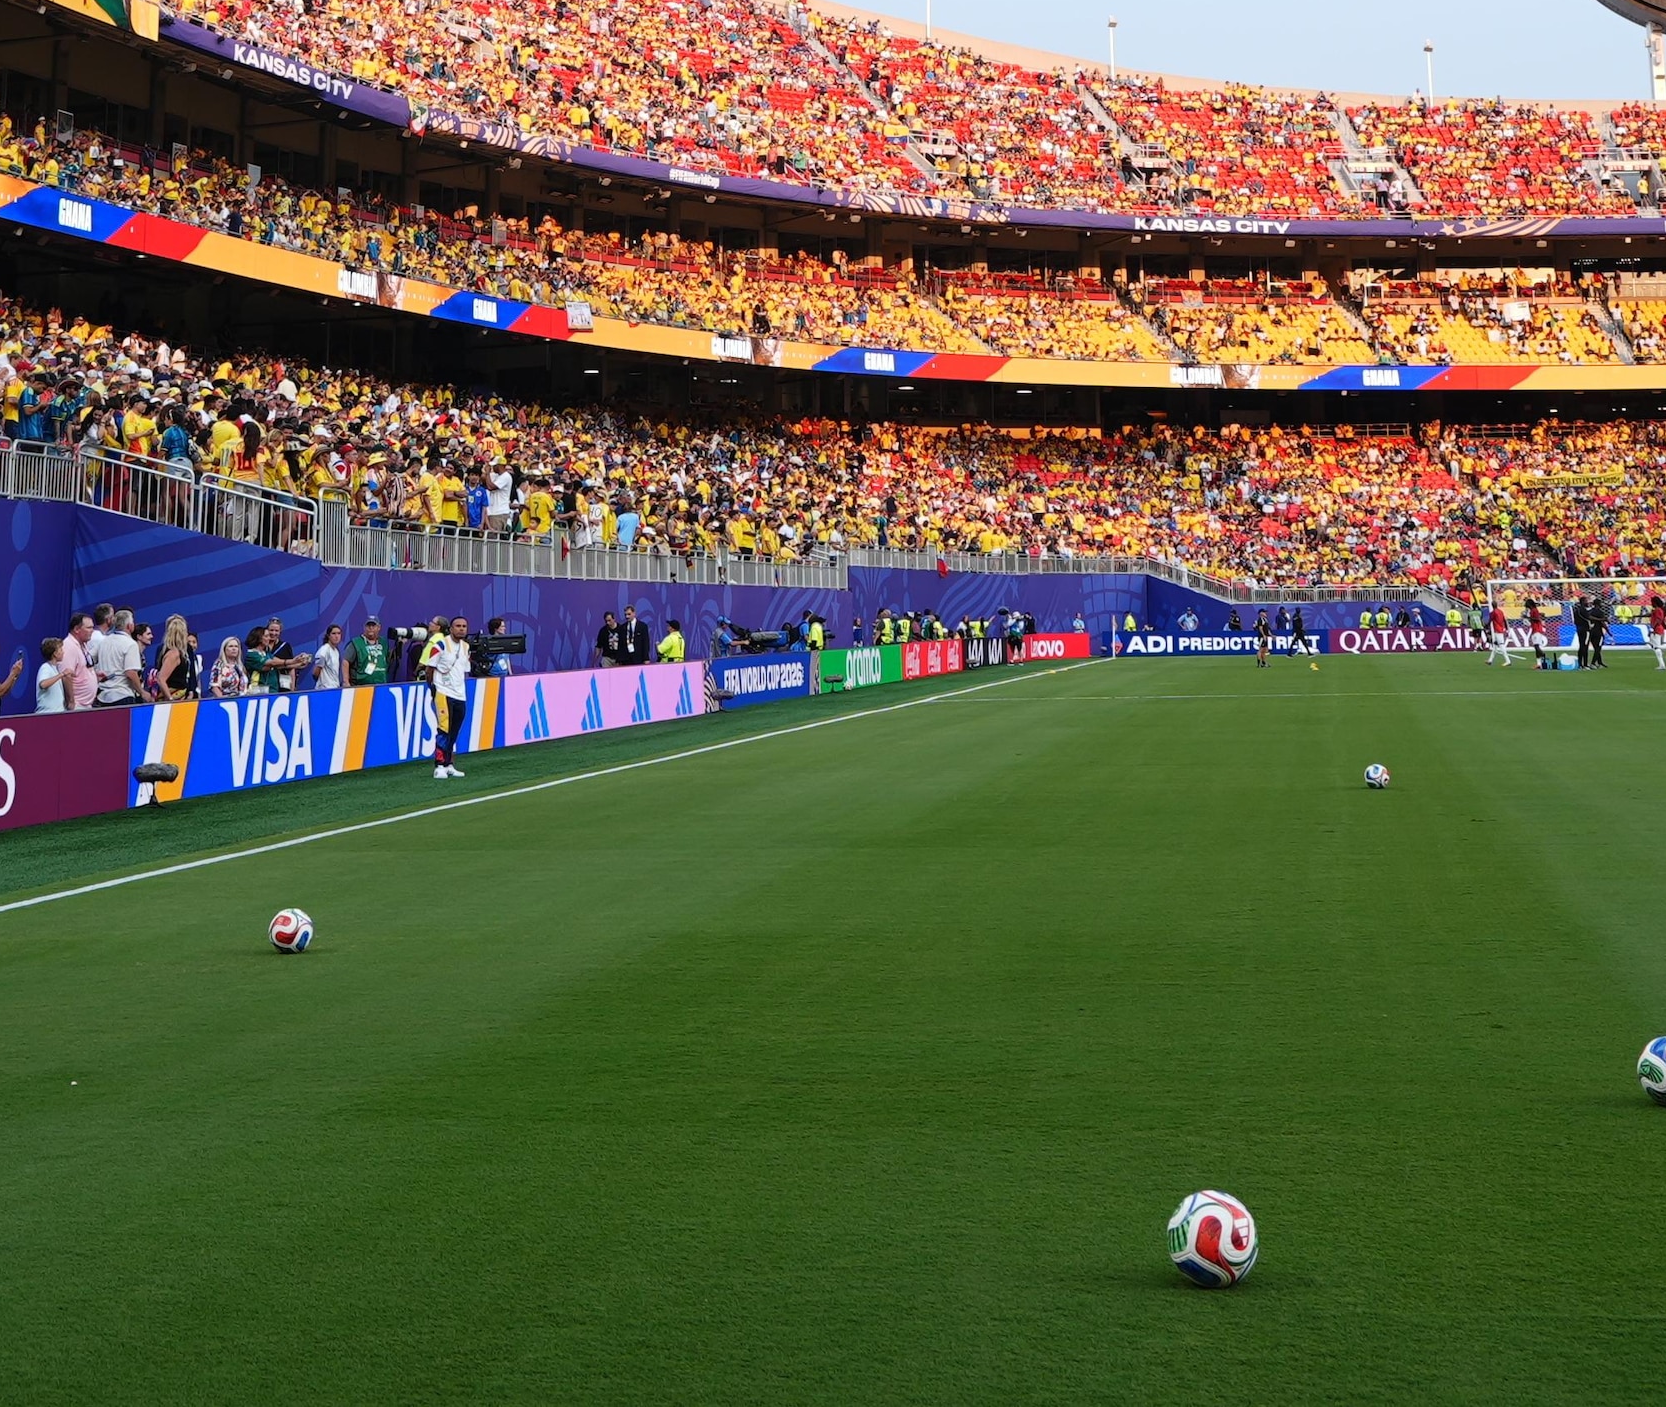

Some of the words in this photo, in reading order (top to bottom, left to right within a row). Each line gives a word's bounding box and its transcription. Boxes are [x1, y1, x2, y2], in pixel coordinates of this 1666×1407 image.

[233, 44, 312, 87] KANSAS
[313, 71, 353, 100] CITY
[58, 197, 92, 232] GHANA
[1134, 216, 1232, 233] KANSAS
[1235, 220, 1290, 235] CITY
[337, 268, 377, 299] COLOMBIA
[473, 297, 498, 324] GHANA
[1363, 369, 1400, 386] GHANA
[1127, 635, 1173, 653] ADI
[1339, 630, 1426, 653] QATAR
[724, 669, 740, 696] FIFA
[740, 665, 766, 694] WORLD
[767, 665, 780, 690] CUP
[781, 662, 803, 688] 2026
[845, 648, 882, 687] aramco
[389, 684, 456, 761] VIS
[220, 695, 312, 787] VISA
